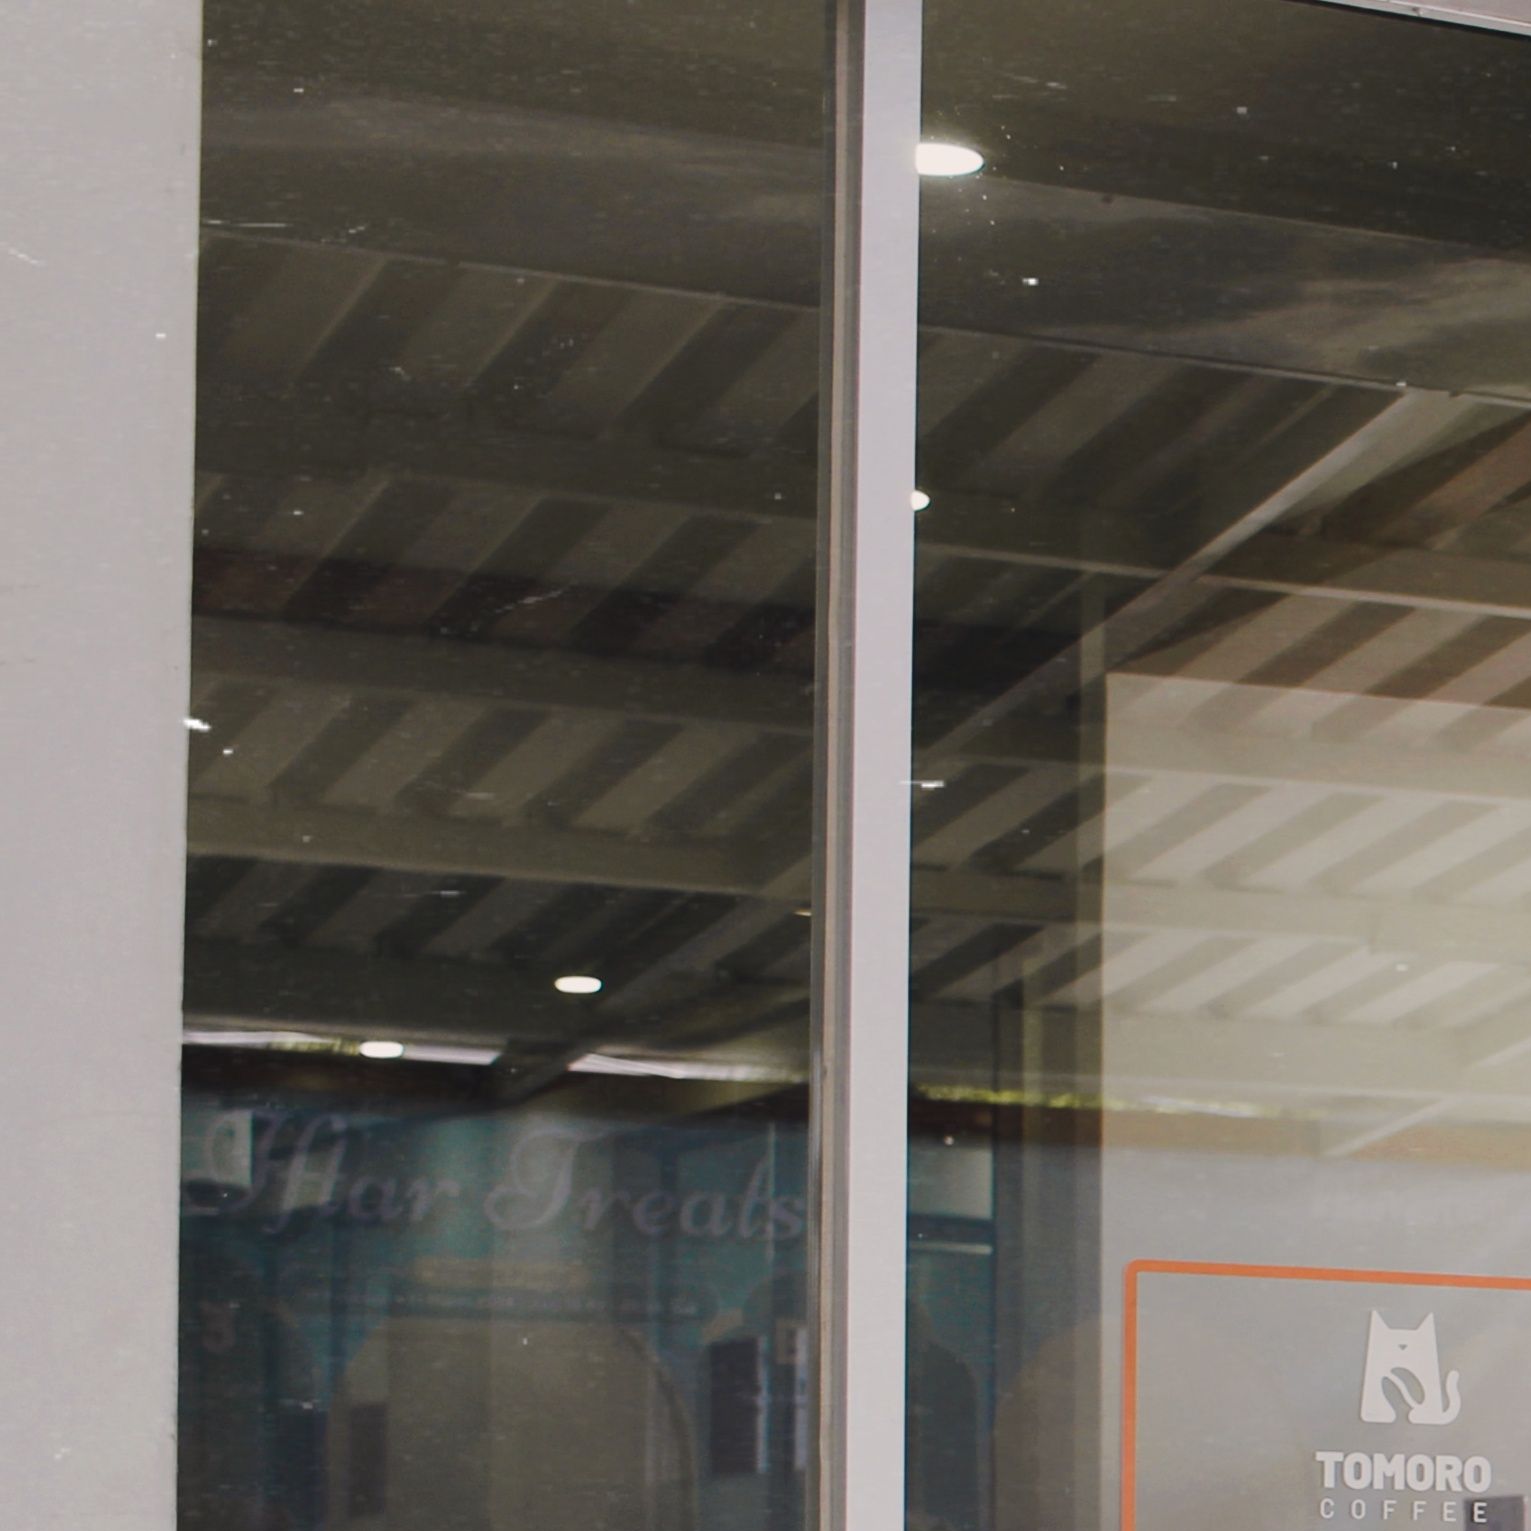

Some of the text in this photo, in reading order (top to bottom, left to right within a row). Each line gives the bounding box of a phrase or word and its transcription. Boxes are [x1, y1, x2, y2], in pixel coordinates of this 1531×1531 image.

[484, 1127, 805, 1239] Treats
[1316, 1450, 1492, 1493] TOMORO
[1319, 1496, 1489, 1524] COFFEE
